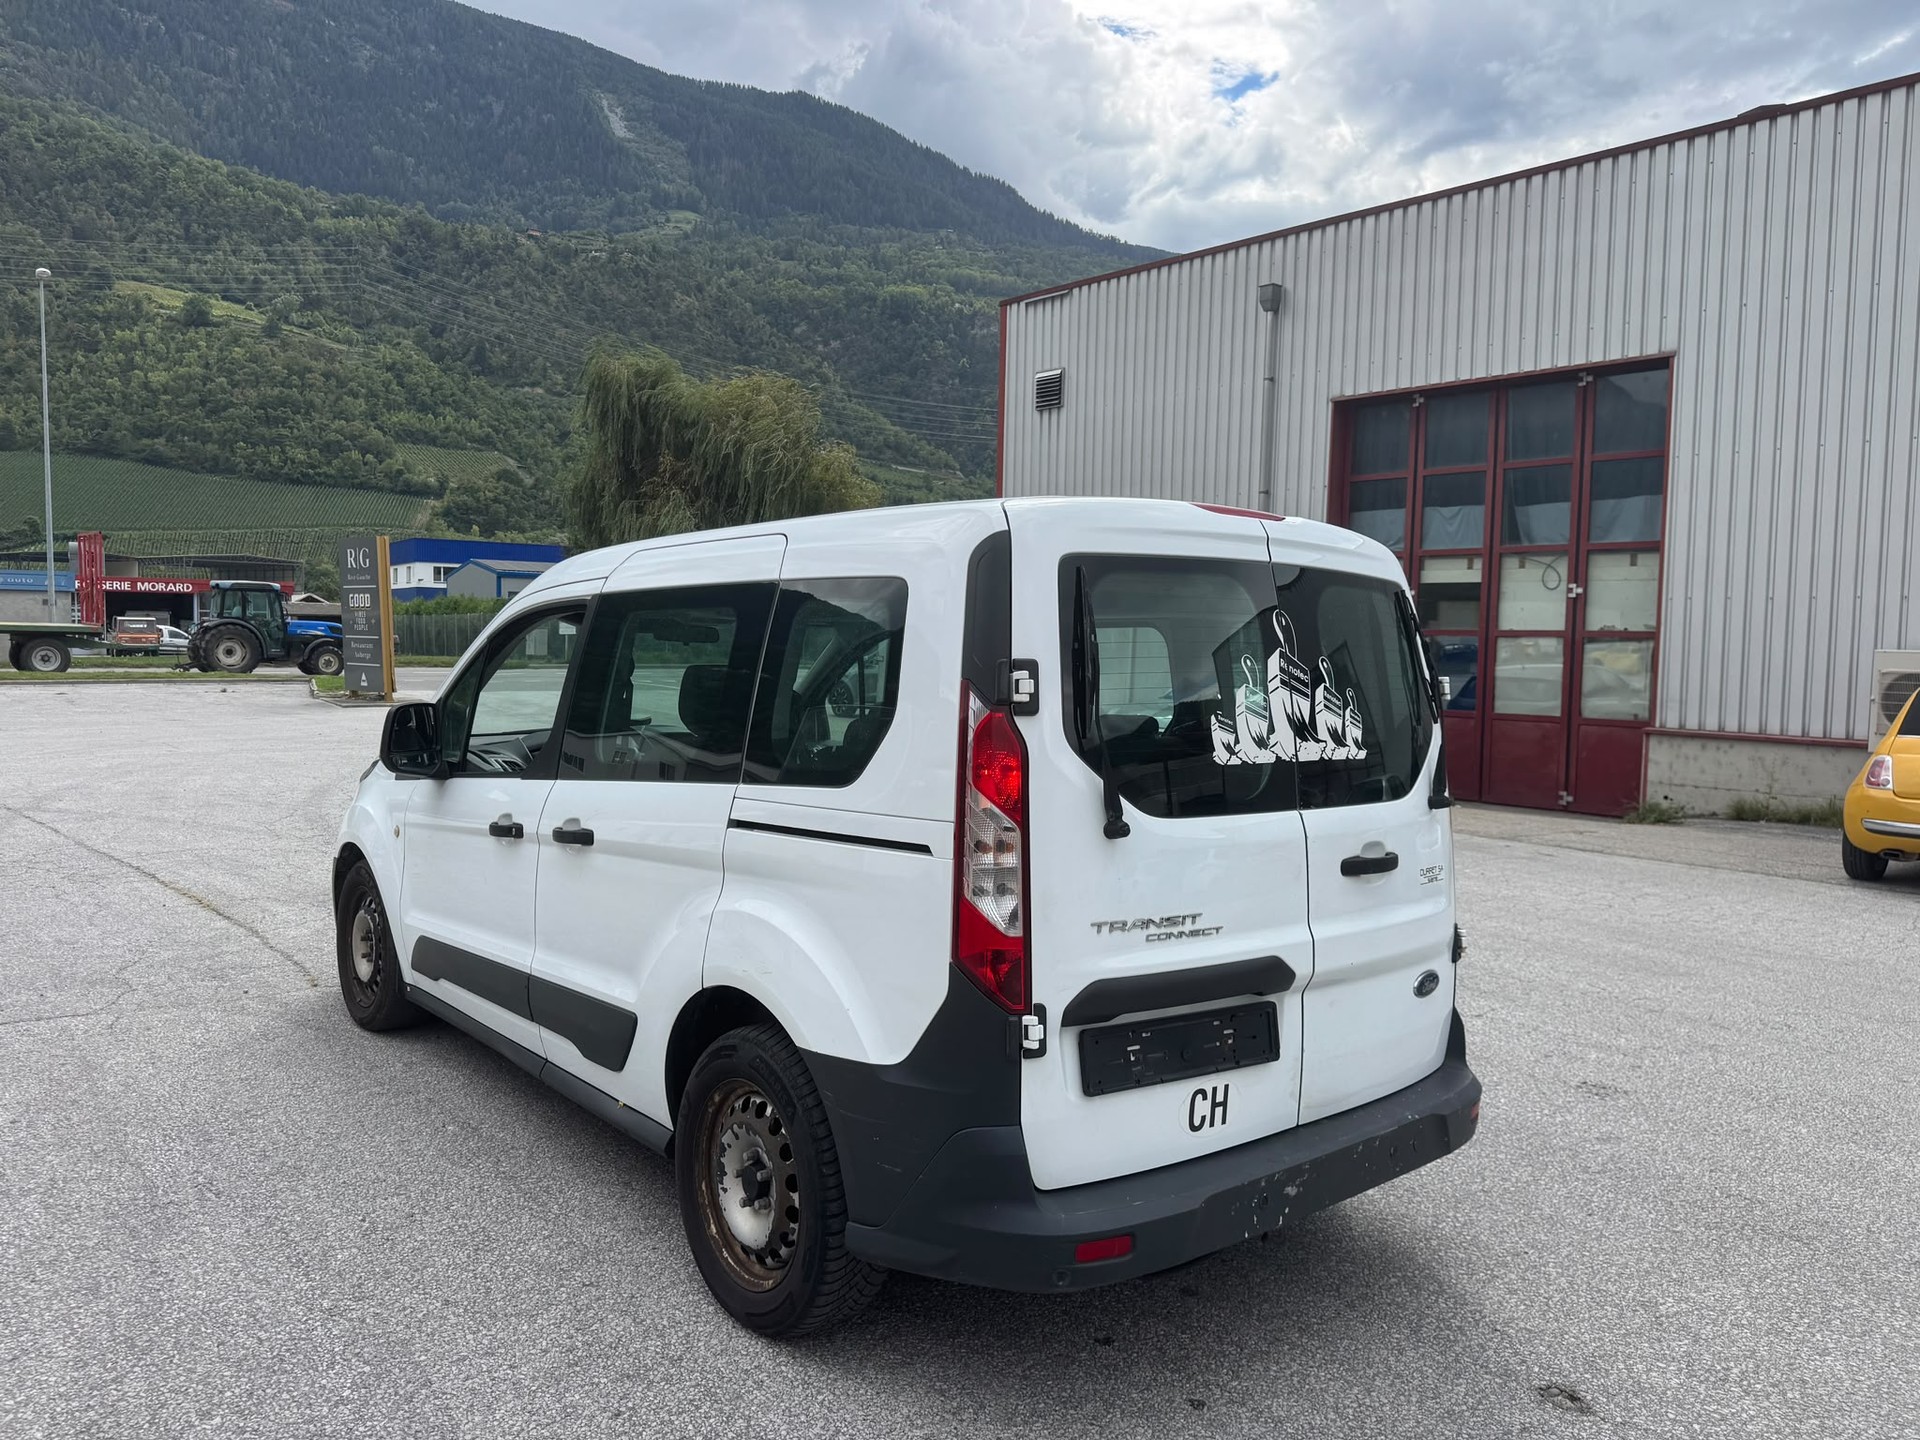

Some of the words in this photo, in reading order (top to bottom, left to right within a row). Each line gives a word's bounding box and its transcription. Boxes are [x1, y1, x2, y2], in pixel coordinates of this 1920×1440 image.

[137, 581, 193, 592] MORARD
[349, 593, 371, 608] GOOD
[1090, 912, 1203, 935] TRANSIT
[1145, 926, 1224, 943] CONNECT
[1188, 1083, 1230, 1133] CH
